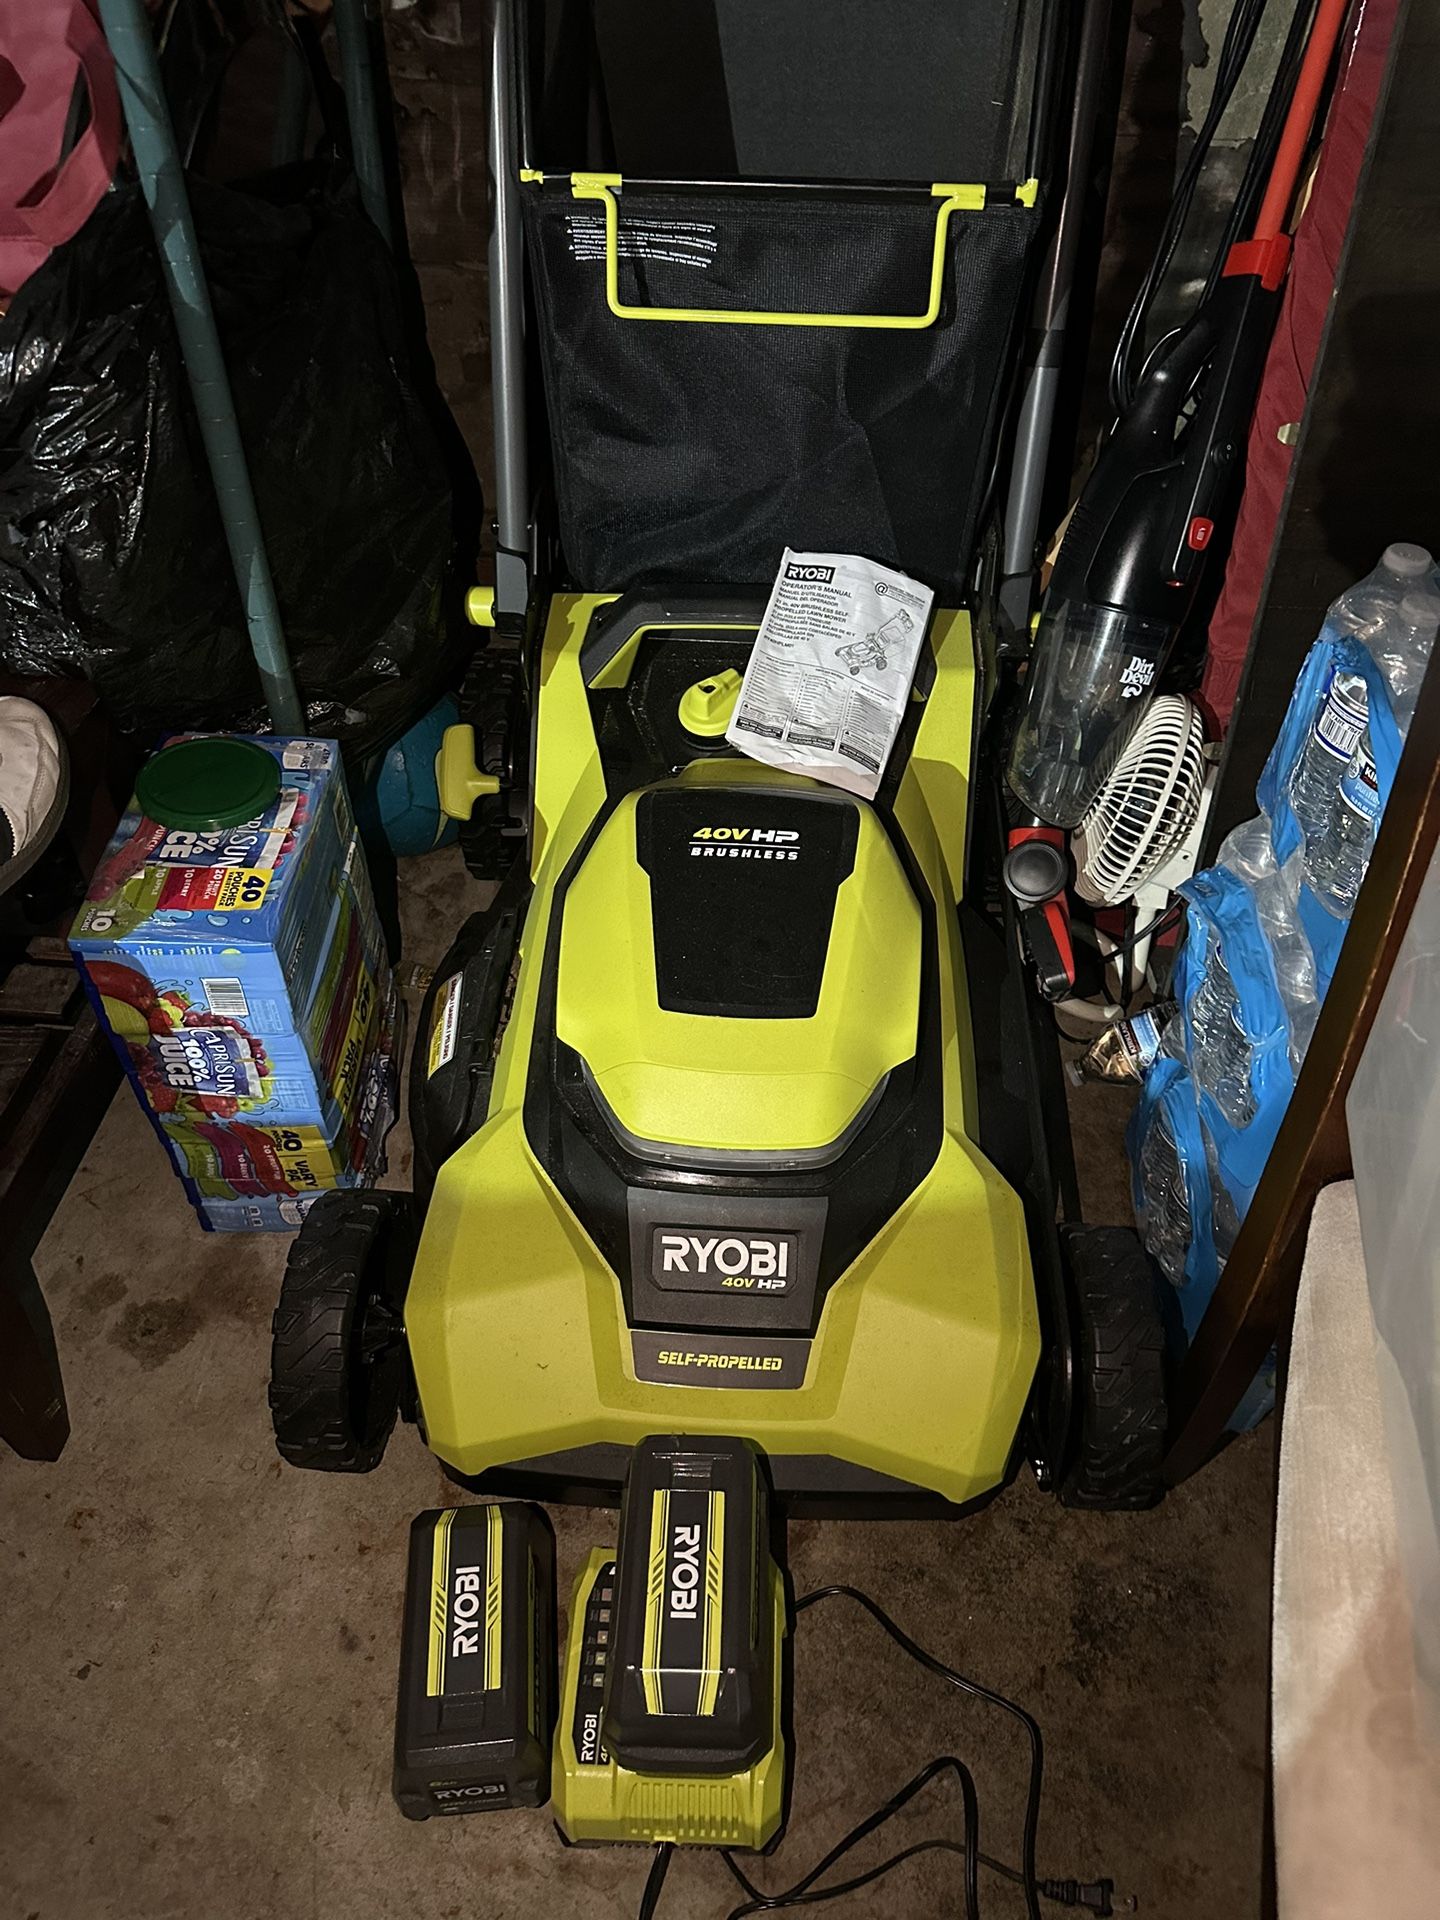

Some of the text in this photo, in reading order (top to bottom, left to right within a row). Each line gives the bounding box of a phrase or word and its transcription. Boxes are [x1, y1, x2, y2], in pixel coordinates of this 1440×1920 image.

[788, 566, 832, 580] RYOBI
[778, 591, 798, 601] MANUAL
[810, 597, 838, 607] OPERADOR
[780, 587, 800, 596] MANUEL
[782, 580, 852, 598] OPERATOR'S MANUAL
[774, 604, 846, 623] PROPELLED LAWN MOWER
[800, 604, 834, 614] BRUSHLESS
[1128, 656, 1154, 674] Dirt
[1119, 668, 1154, 686] Devil
[690, 847, 798, 860] BRUSHLESS
[156, 868, 167, 878] 10
[180, 868, 195, 896] 10 BERRY
[213, 869, 225, 880] 20
[218, 872, 234, 906] VARIETY PACK
[225, 872, 244, 907] POUCHES
[241, 876, 266, 902] 40
[90, 908, 116, 932] 10
[152, 1034, 194, 1087] JUICE
[182, 1038, 211, 1083] 100%
[190, 1029, 237, 1094] CAPRISUN
[281, 1130, 302, 1152] 40
[662, 1236, 788, 1278] RYOBI
[721, 1277, 787, 1290] 40V HP
[658, 1350, 782, 1372] SELF-PROPELLED
[670, 1524, 700, 1620] RYOBI
[452, 1566, 480, 1658] RYOBI
[580, 1714, 598, 1762] RYOBI
[434, 1784, 506, 1800] RYOBI
